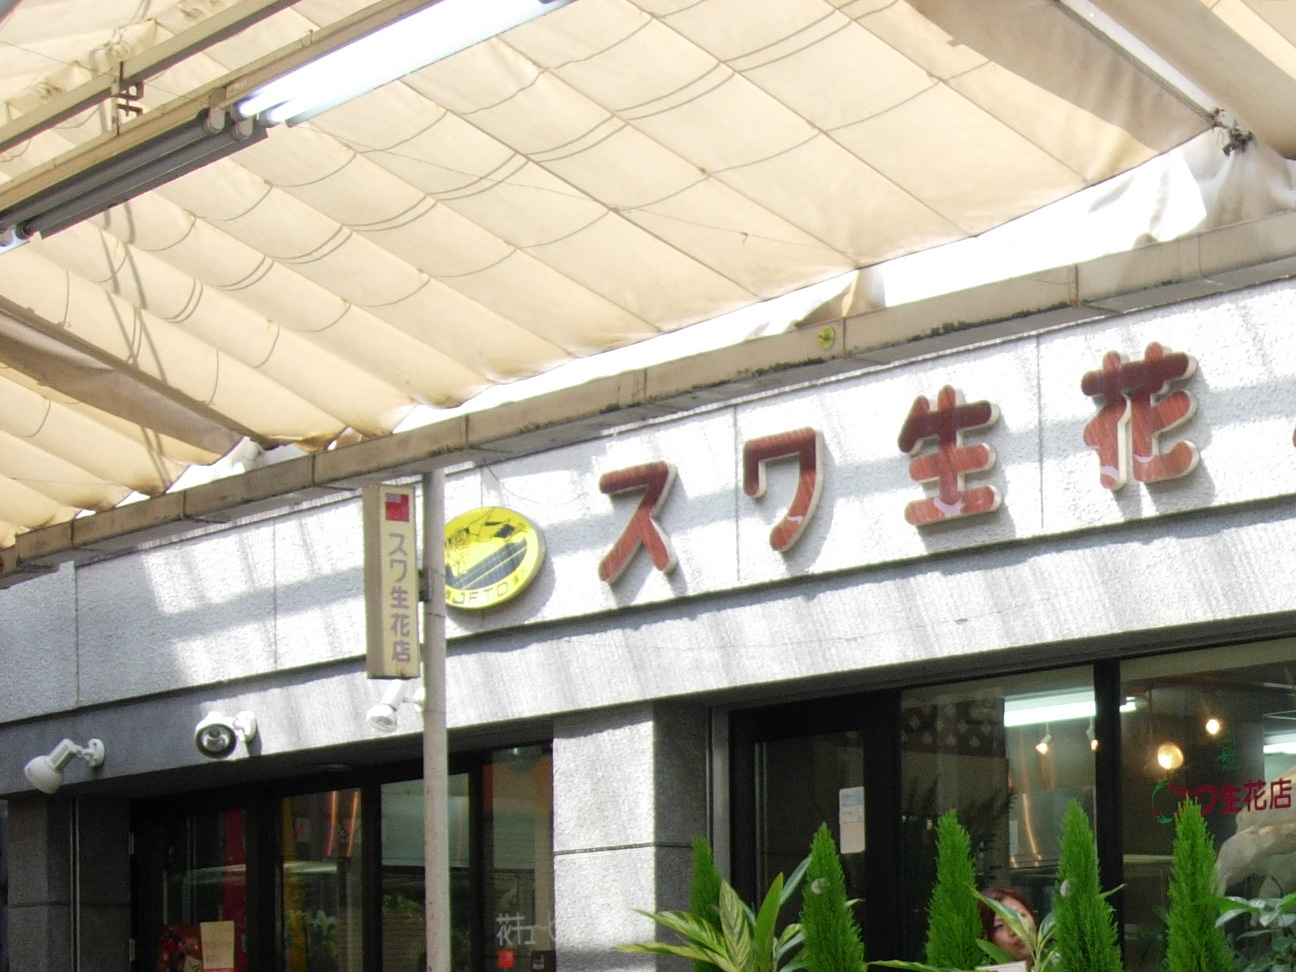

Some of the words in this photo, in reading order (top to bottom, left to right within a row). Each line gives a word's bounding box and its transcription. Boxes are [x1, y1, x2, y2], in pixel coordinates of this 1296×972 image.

[388, 532, 411, 663] スワ生花店
